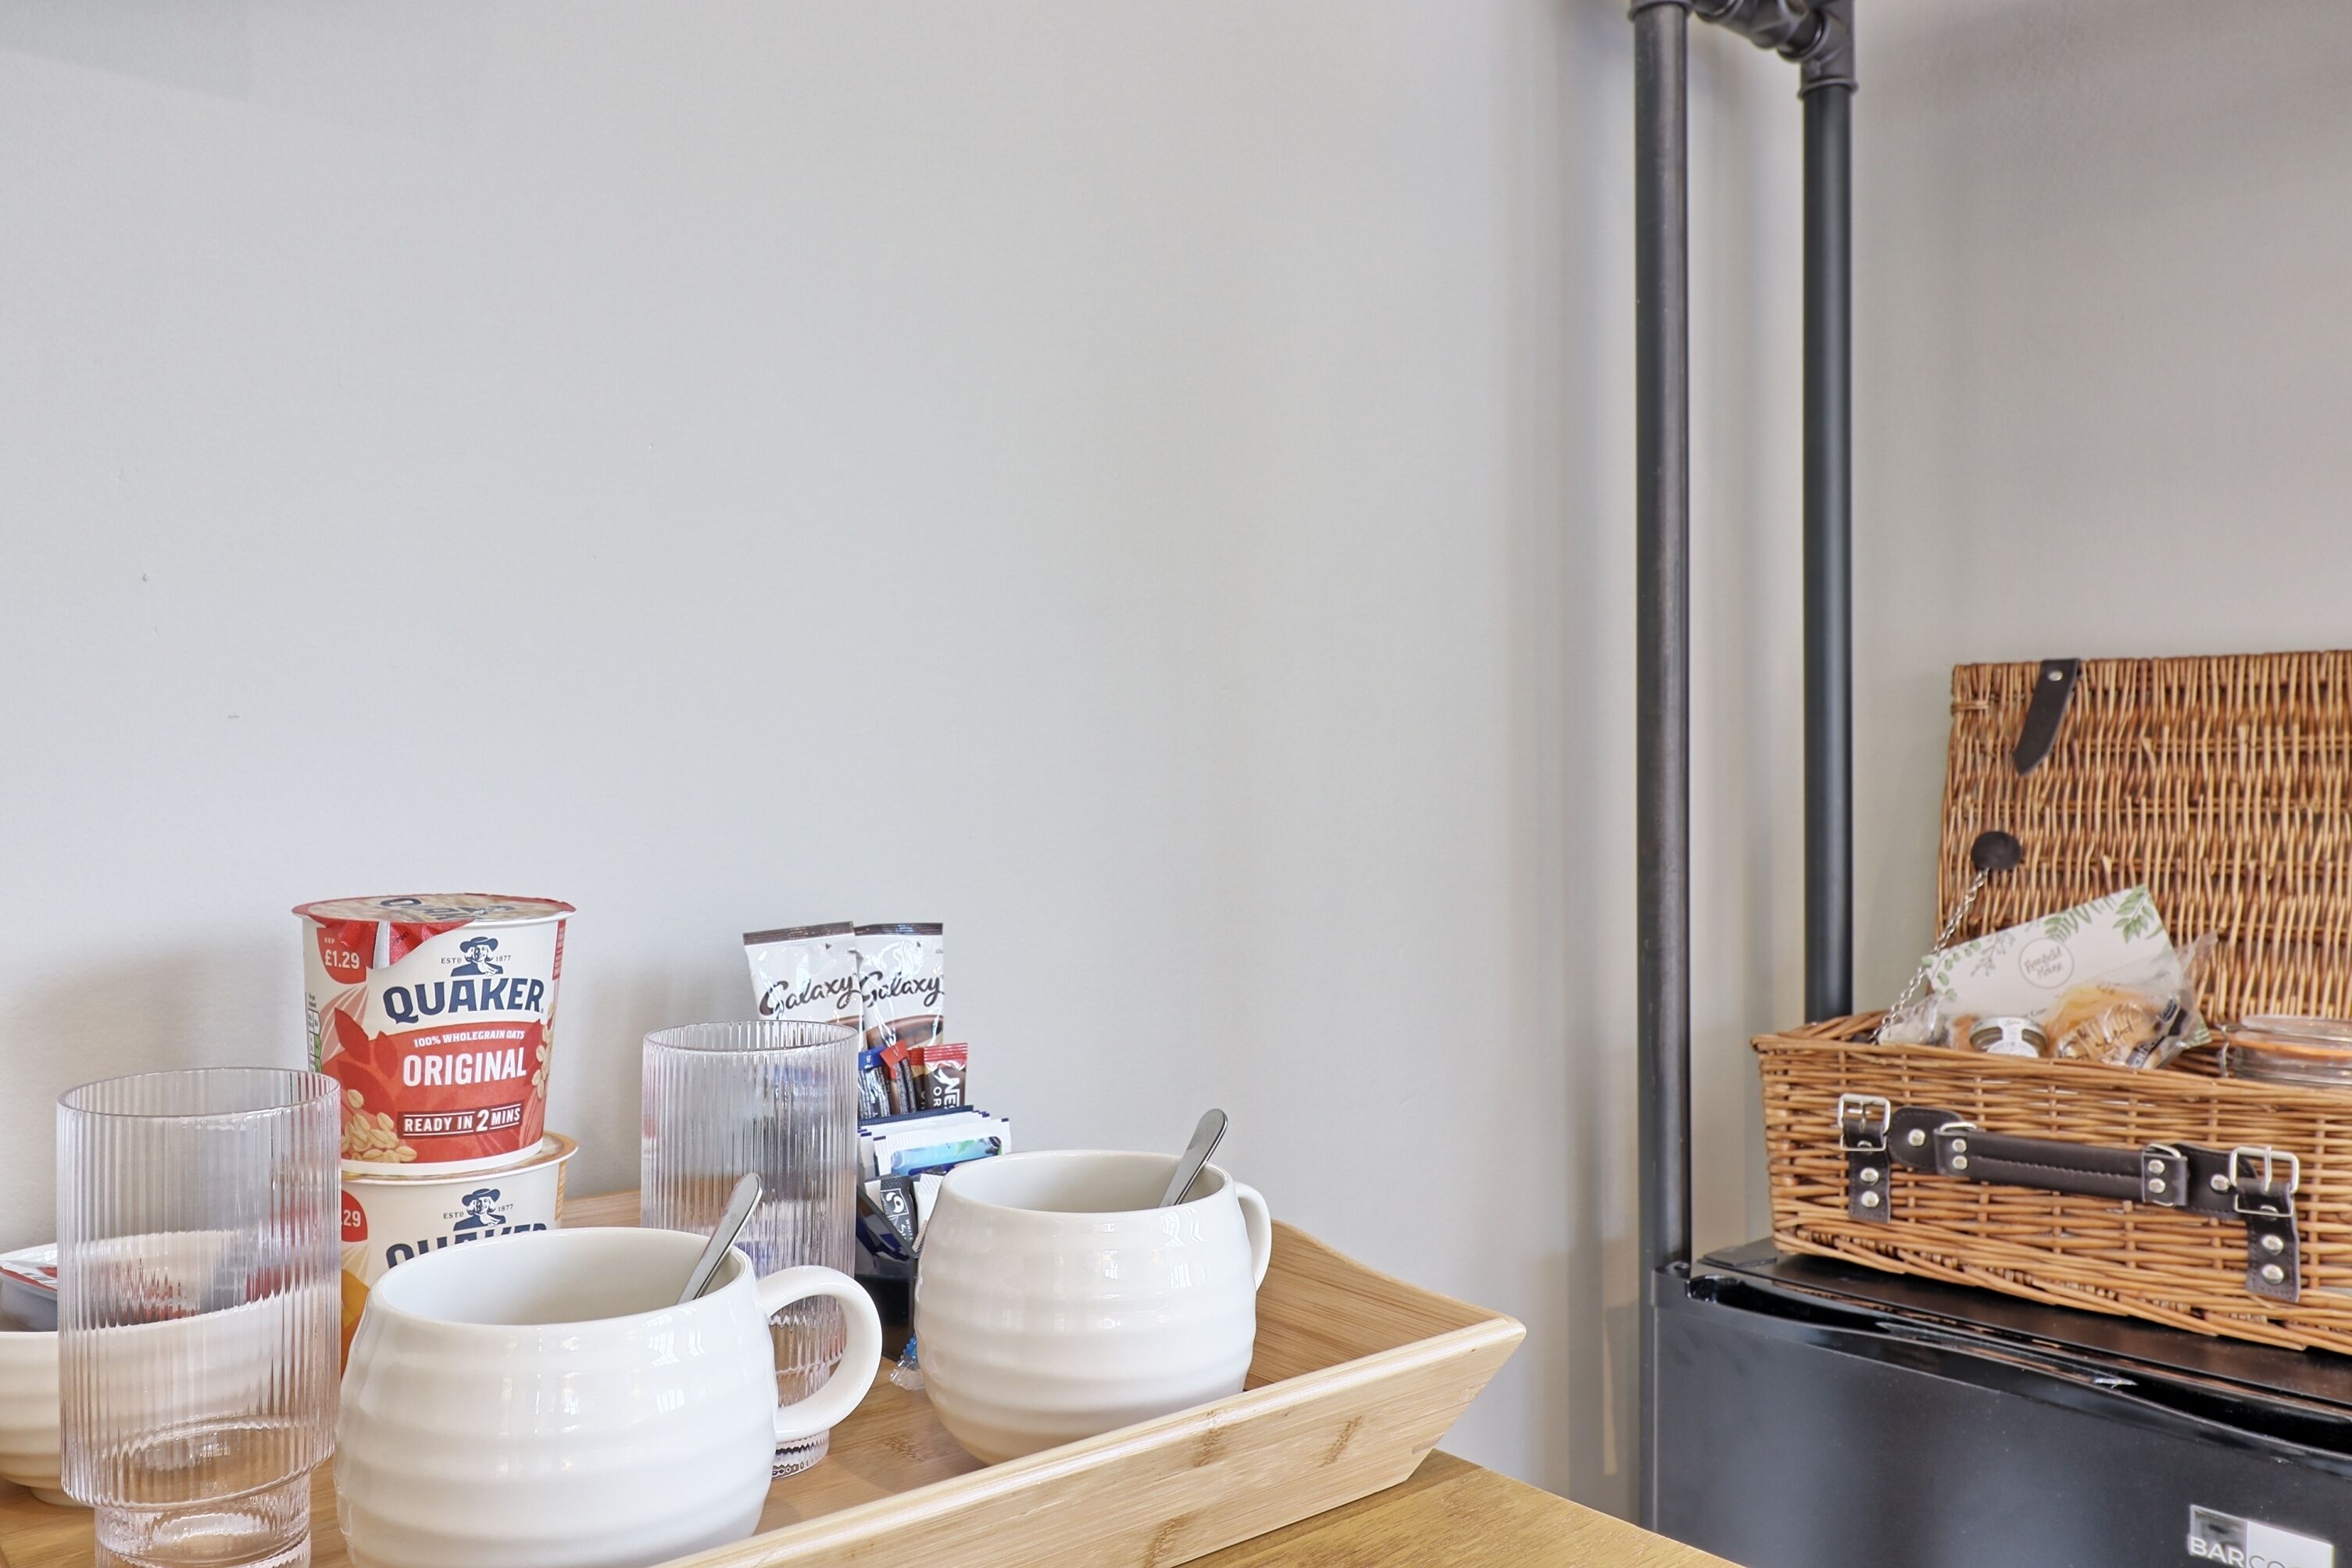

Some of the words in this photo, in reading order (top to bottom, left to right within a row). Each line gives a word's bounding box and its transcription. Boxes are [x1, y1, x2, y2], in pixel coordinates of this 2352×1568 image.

[324, 949, 360, 970] £1.29
[382, 977, 545, 1024] QUAKER
[760, 973, 860, 1017] Galaxy
[860, 970, 944, 1009] Galaxy
[413, 1036, 441, 1048] 100%
[443, 1031, 505, 1045] WHOLEGRAIN
[506, 1030, 525, 1040] OATS
[402, 1047, 527, 1088] ORIGINAL
[933, 1068, 960, 1110] NE
[405, 1116, 452, 1132] READY
[457, 1116, 473, 1129] IN
[476, 1109, 488, 1131] 2
[491, 1108, 520, 1126] MINS
[498, 1204, 513, 1213] 1877
[2189, 1536, 2299, 1568] BARC
